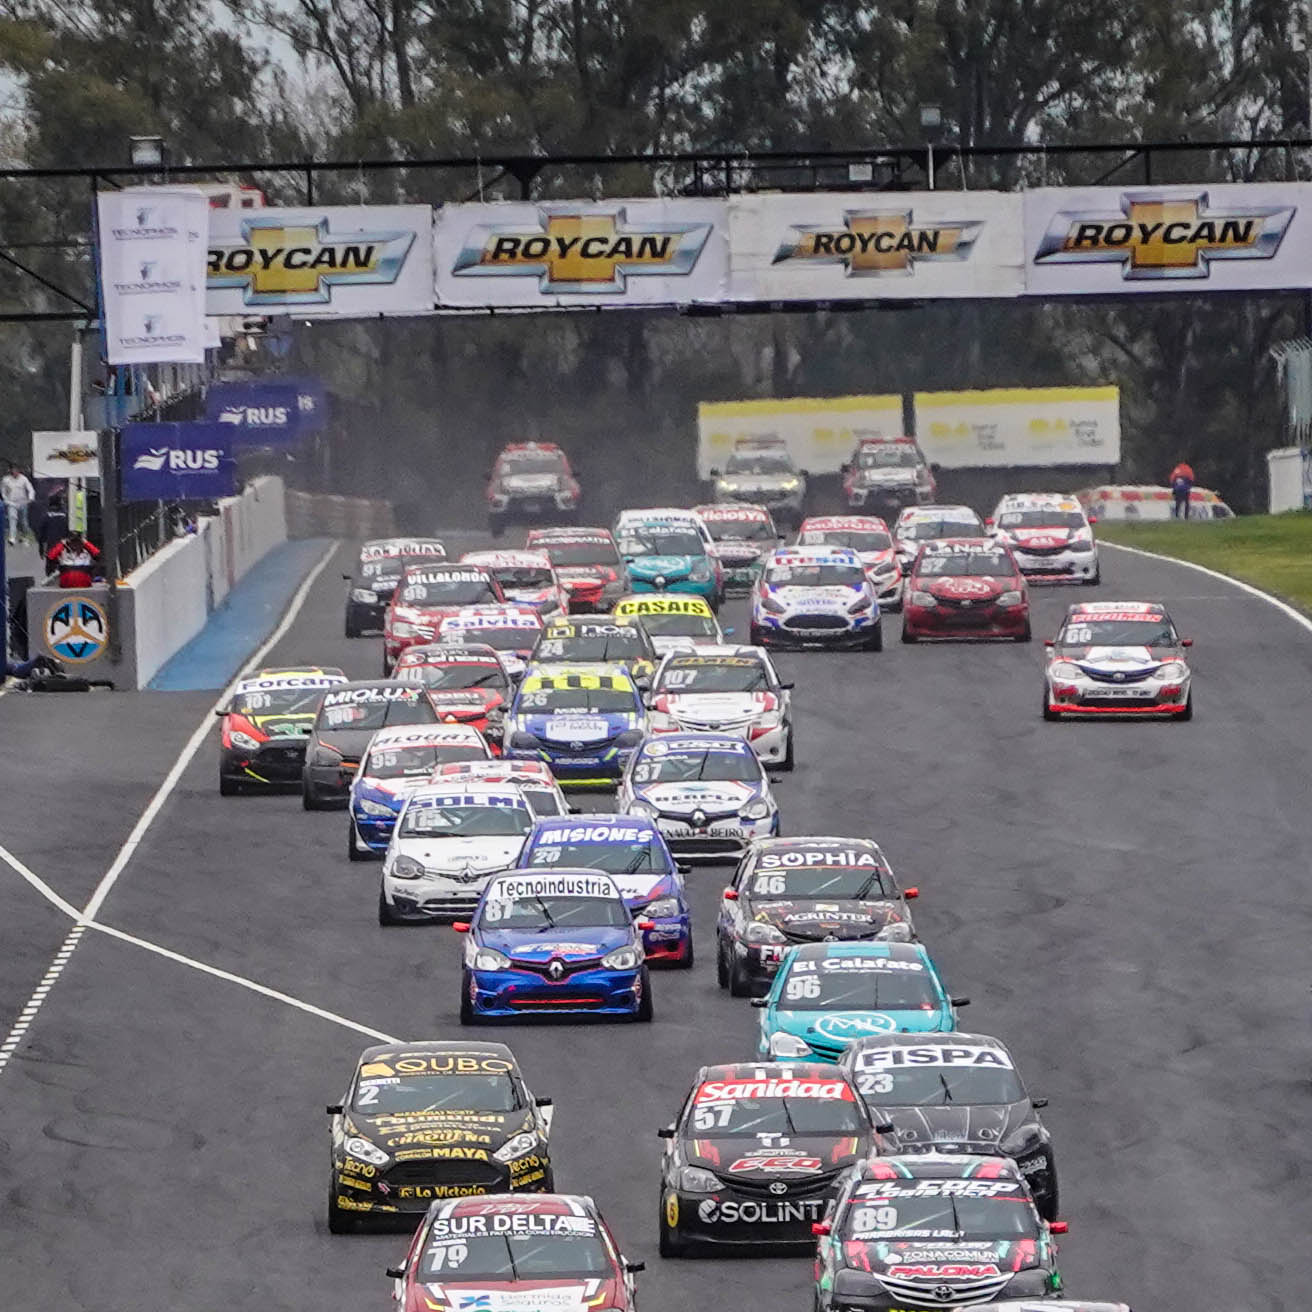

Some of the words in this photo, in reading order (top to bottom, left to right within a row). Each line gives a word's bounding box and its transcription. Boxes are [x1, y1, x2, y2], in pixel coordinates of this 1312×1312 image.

[813, 230, 939, 255] ROYCAN
[1074, 219, 1256, 247] ROYCAN
[491, 236, 671, 261] ROYCAN
[247, 407, 287, 424] RUS
[169, 449, 219, 470] RUS
[620, 601, 705, 616] CASAIS
[446, 615, 537, 628] Salvita
[663, 670, 699, 686] 107
[635, 763, 663, 782] 37
[539, 827, 654, 845] MISIONES
[497, 876, 612, 898] Tecnoindustria
[754, 876, 787, 895] 46
[793, 961, 817, 972] El
[822, 957, 924, 972] Calafate
[787, 980, 822, 1000] 96
[395, 1057, 515, 1074] QUBO
[861, 1048, 1005, 1067] FISPA
[699, 1079, 847, 1103] Sanidad
[858, 1074, 895, 1095] 23
[358, 1085, 380, 1107] 2
[694, 1104, 734, 1130] 57
[433, 1147, 489, 1161] MAYA
[434, 1217, 487, 1236] SUR
[494, 1214, 574, 1231] DELTA
[853, 1207, 898, 1232] 89
[427, 1245, 468, 1272] 79
